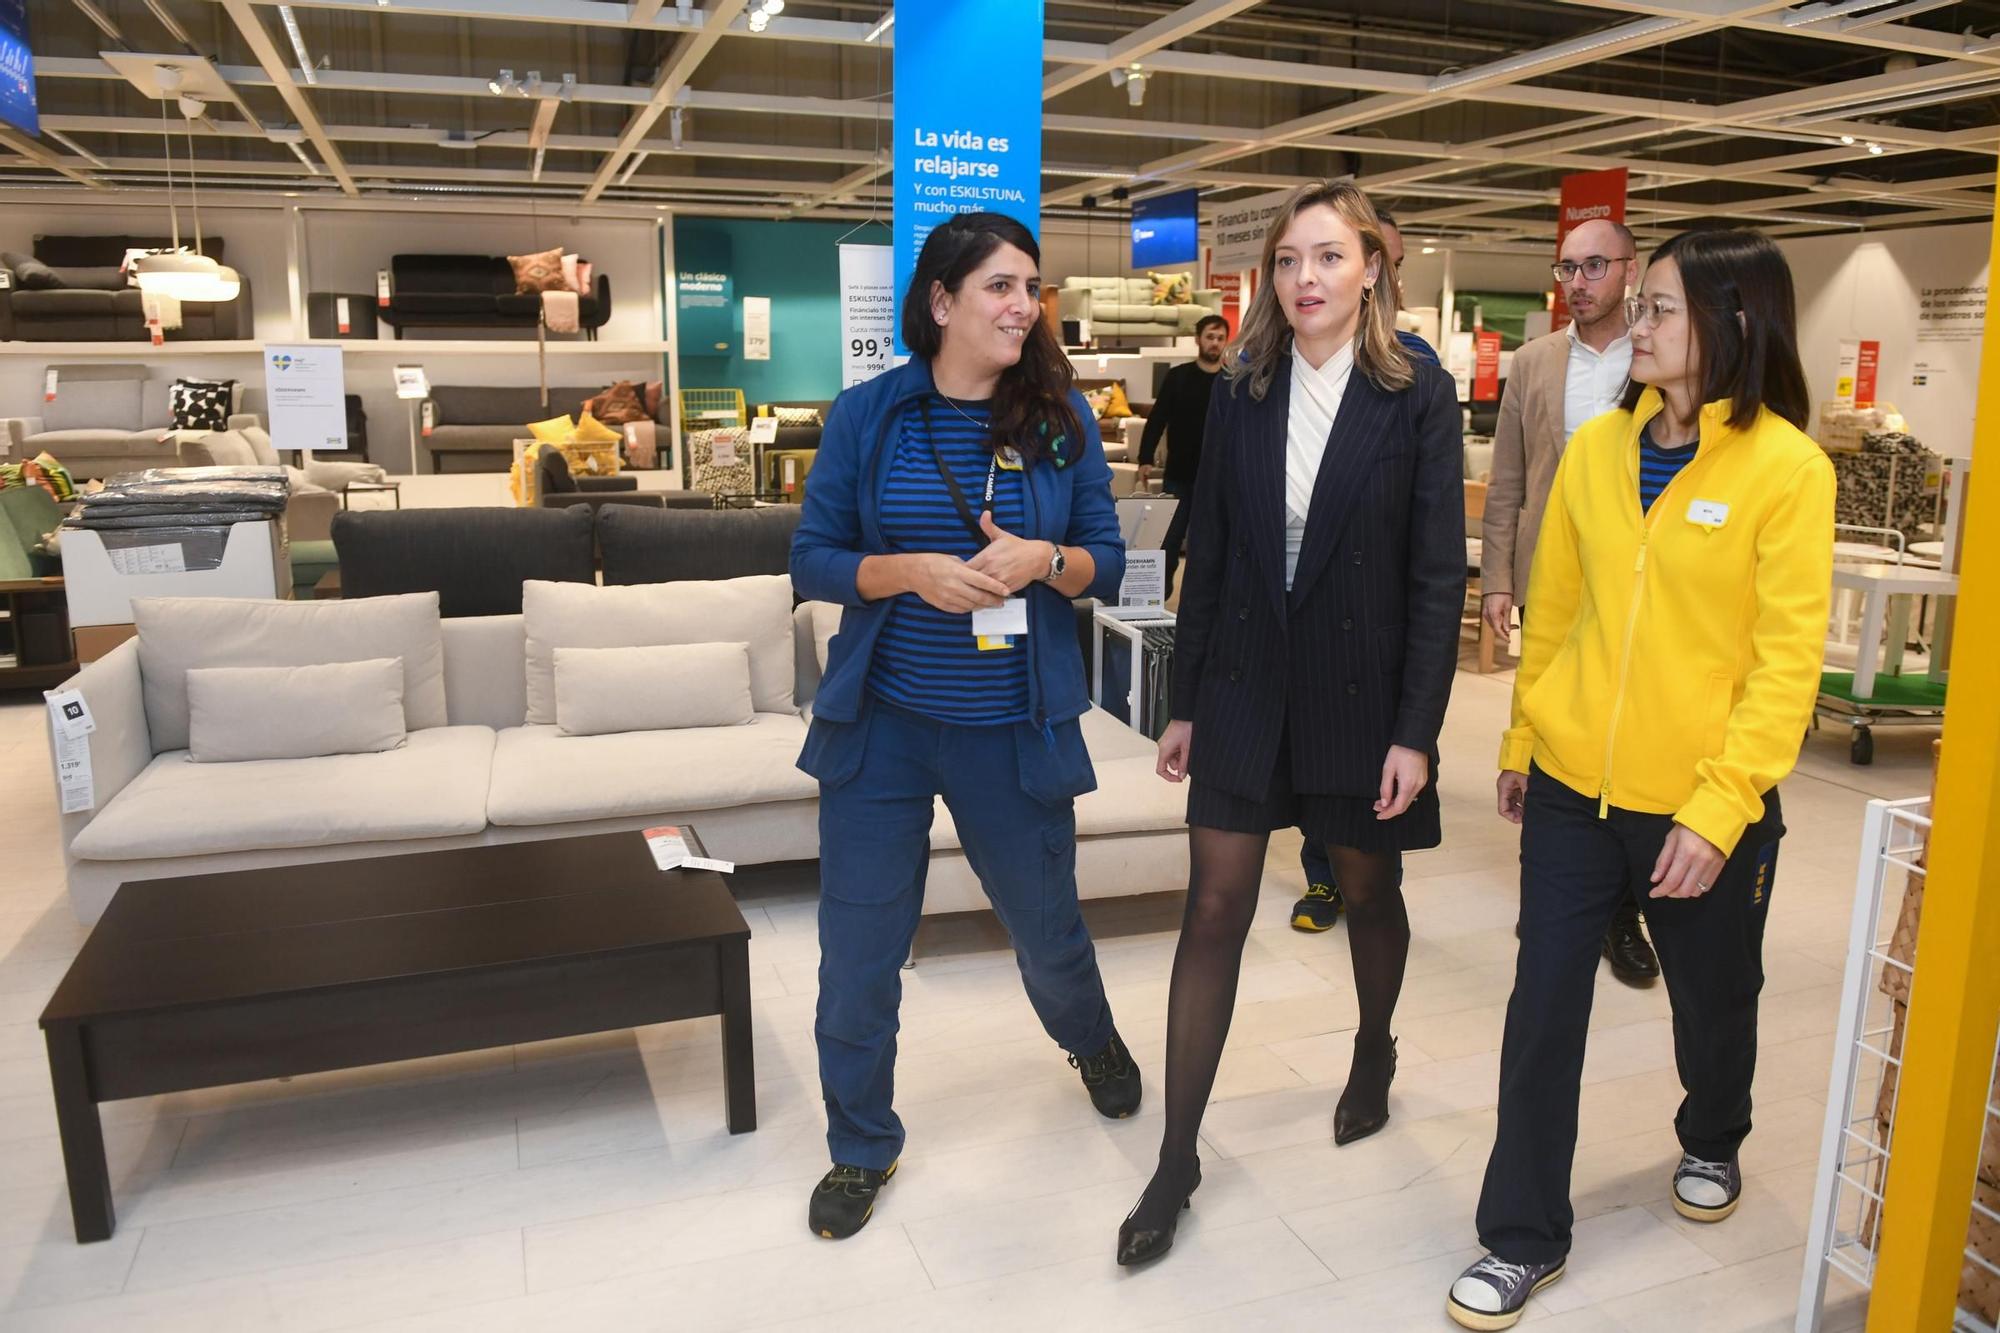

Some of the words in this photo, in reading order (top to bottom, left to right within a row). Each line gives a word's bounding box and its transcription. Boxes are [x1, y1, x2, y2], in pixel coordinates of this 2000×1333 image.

[914, 128, 938, 147] La
[941, 129, 983, 151] vida
[987, 137, 1009, 152] es
[914, 155, 999, 180] relajarse
[913, 183, 922, 195] Y
[924, 186, 947, 197] con
[950, 185, 1025, 203] ESKILSTUNA,
[914, 201, 956, 214] mucho
[959, 203, 984, 214] más
[1566, 204, 1611, 221] Nuestro
[1217, 210, 1249, 227] Financia
[1250, 209, 1259, 221] tu
[1261, 205, 1283, 219] com
[1217, 231, 1225, 246] 10
[1226, 230, 1251, 244] meses
[1252, 225, 1264, 240] sin
[679, 272, 694, 281] Un
[695, 271, 727, 282] clásico
[679, 282, 723, 291] moderno
[1921, 287, 1932, 297] La
[849, 295, 893, 303] ESKILSTUNA
[1921, 300, 1931, 308] de
[1933, 299, 1946, 308] los
[1920, 311, 1930, 320] de
[1932, 312, 1971, 320] nuestros
[1973, 312, 1986, 320] so
[866, 363, 886, 371] 999€
[67, 705, 79, 716] 10
[1754, 862, 1767, 904] IKEA
